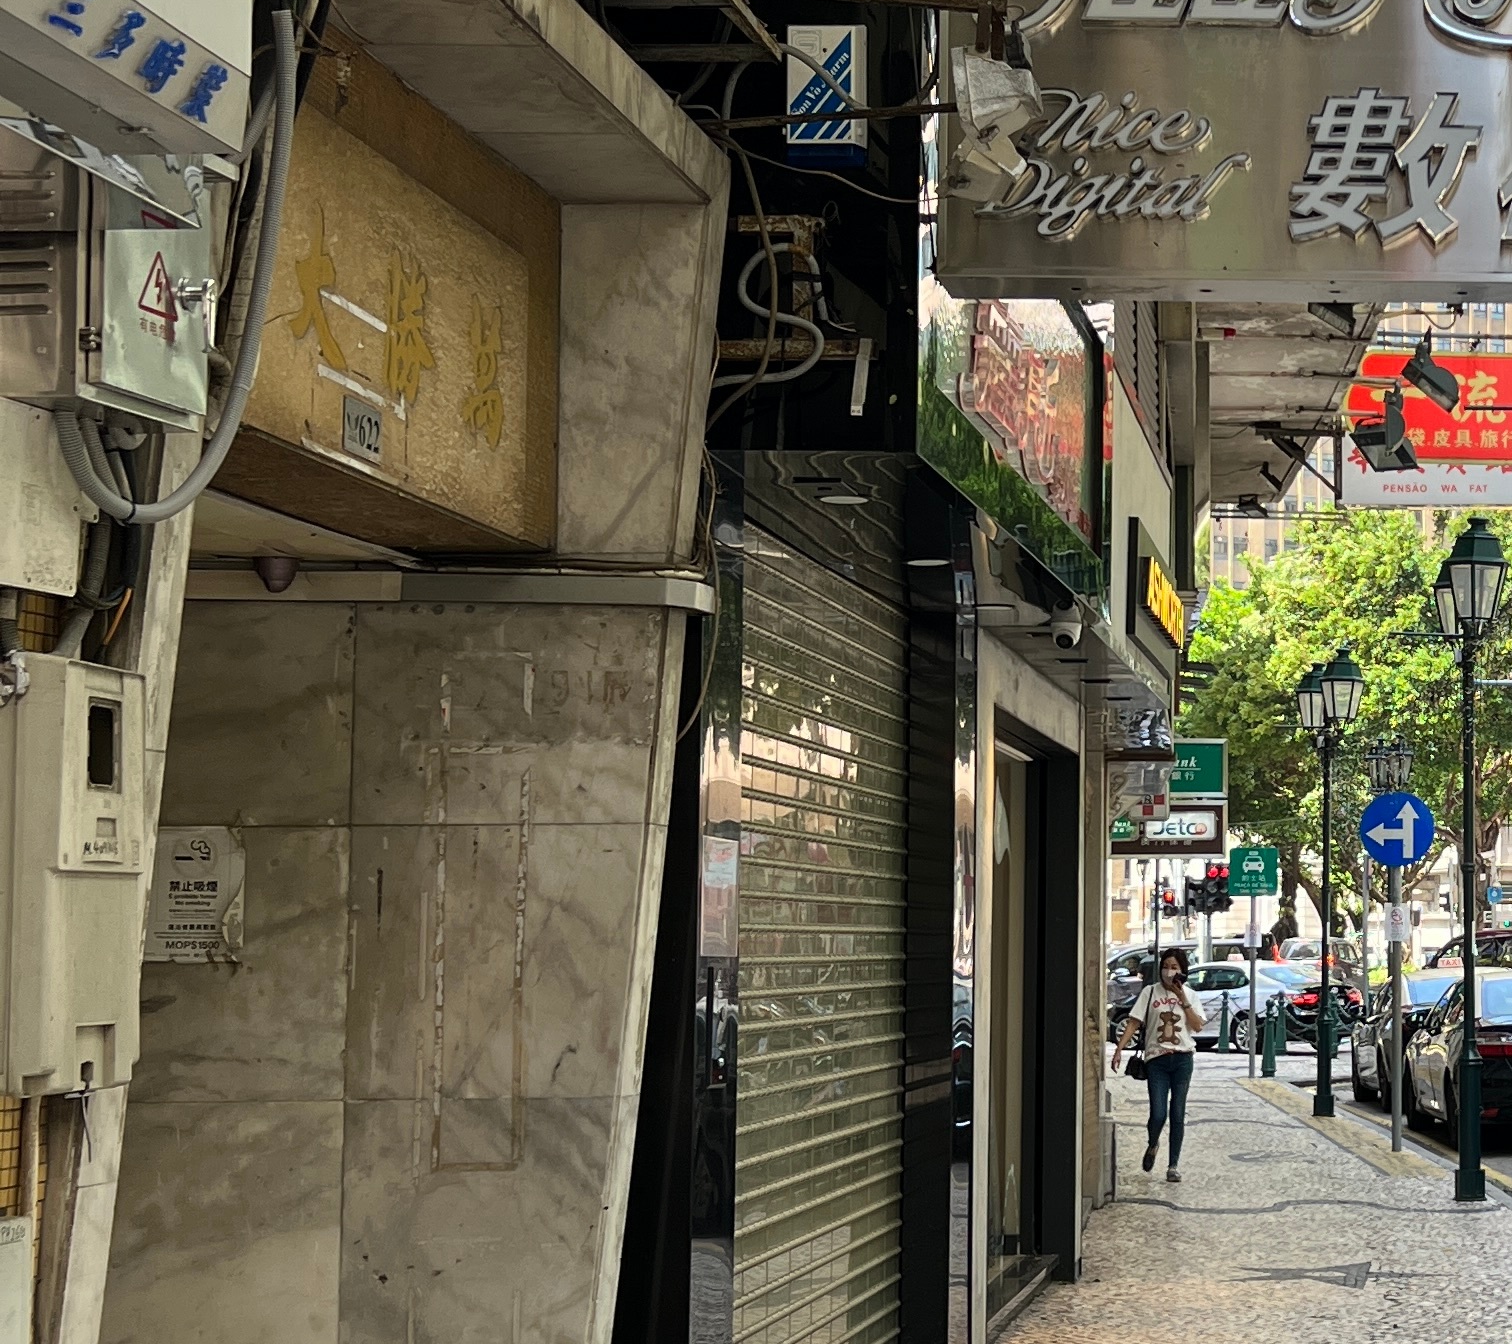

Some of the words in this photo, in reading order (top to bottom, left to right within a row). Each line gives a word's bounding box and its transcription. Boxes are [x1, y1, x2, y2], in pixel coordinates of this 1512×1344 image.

[1035, 88, 1213, 155] Nice
[974, 152, 1252, 240] Digital
[359, 414, 380, 454] 622
[1382, 482, 1428, 493] PENSÃO
[1441, 484, 1458, 493] WA
[1469, 484, 1488, 493] FAT
